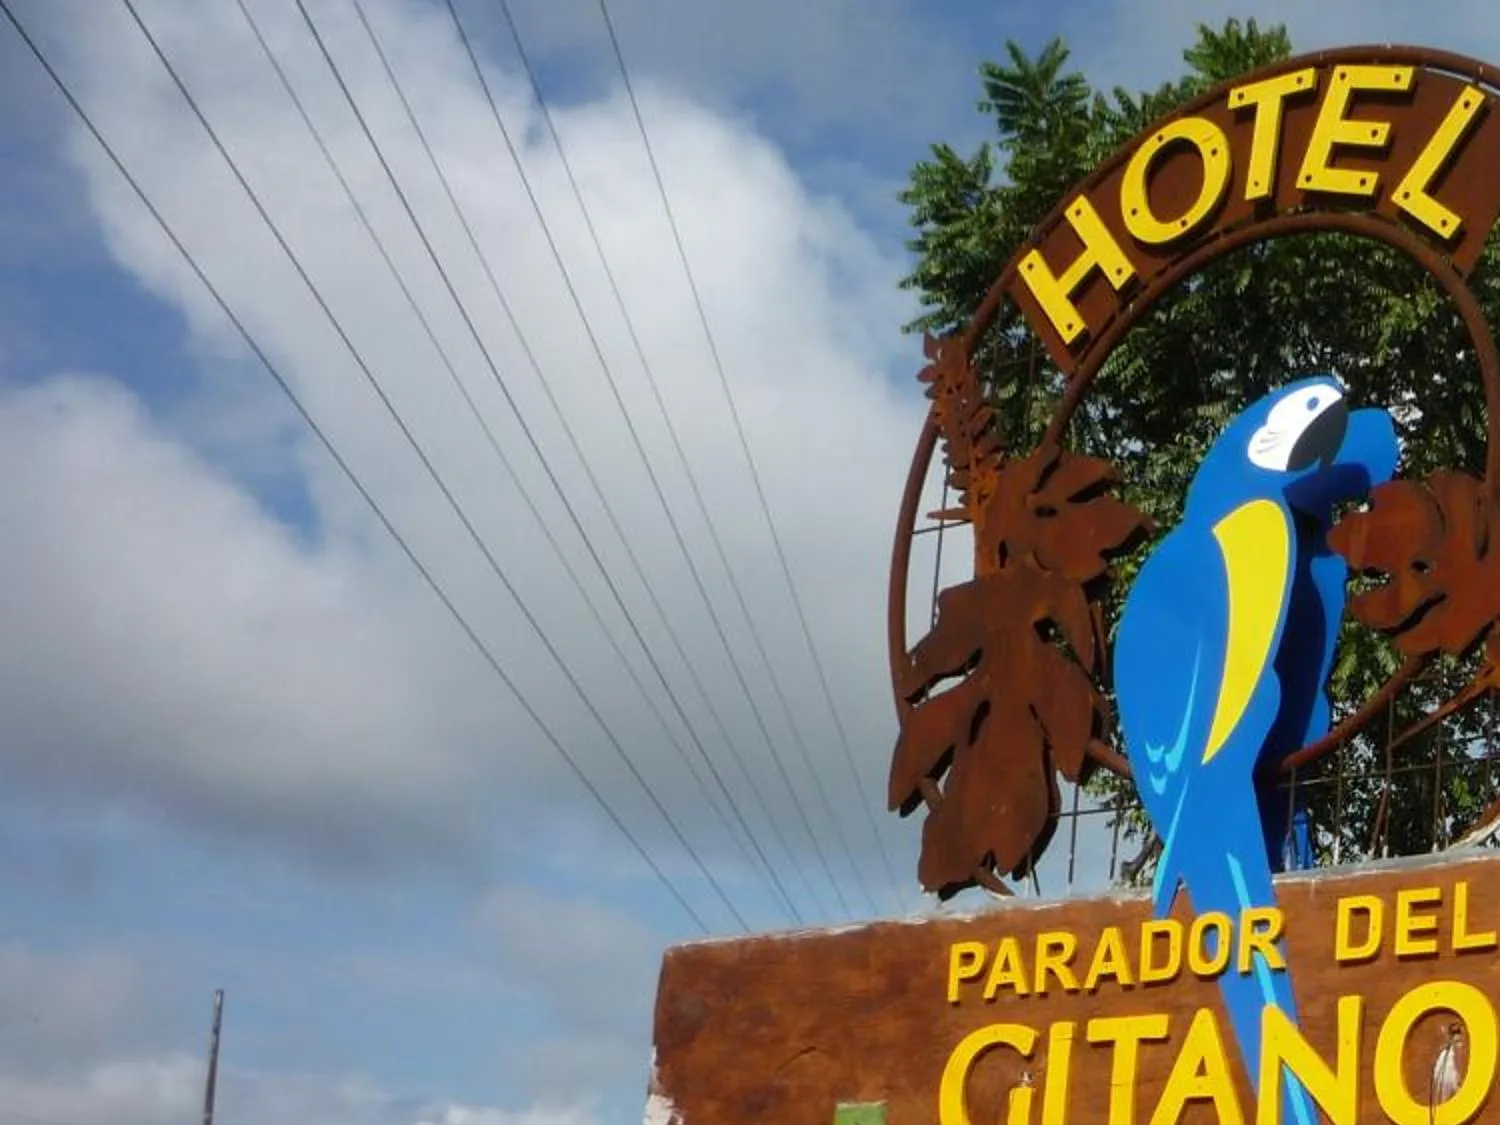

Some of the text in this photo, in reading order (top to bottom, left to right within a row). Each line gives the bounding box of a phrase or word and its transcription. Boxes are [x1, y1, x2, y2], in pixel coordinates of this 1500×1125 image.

[1017, 64, 1487, 345] HOTEL
[947, 881, 1498, 1002] PARADOR DEL
